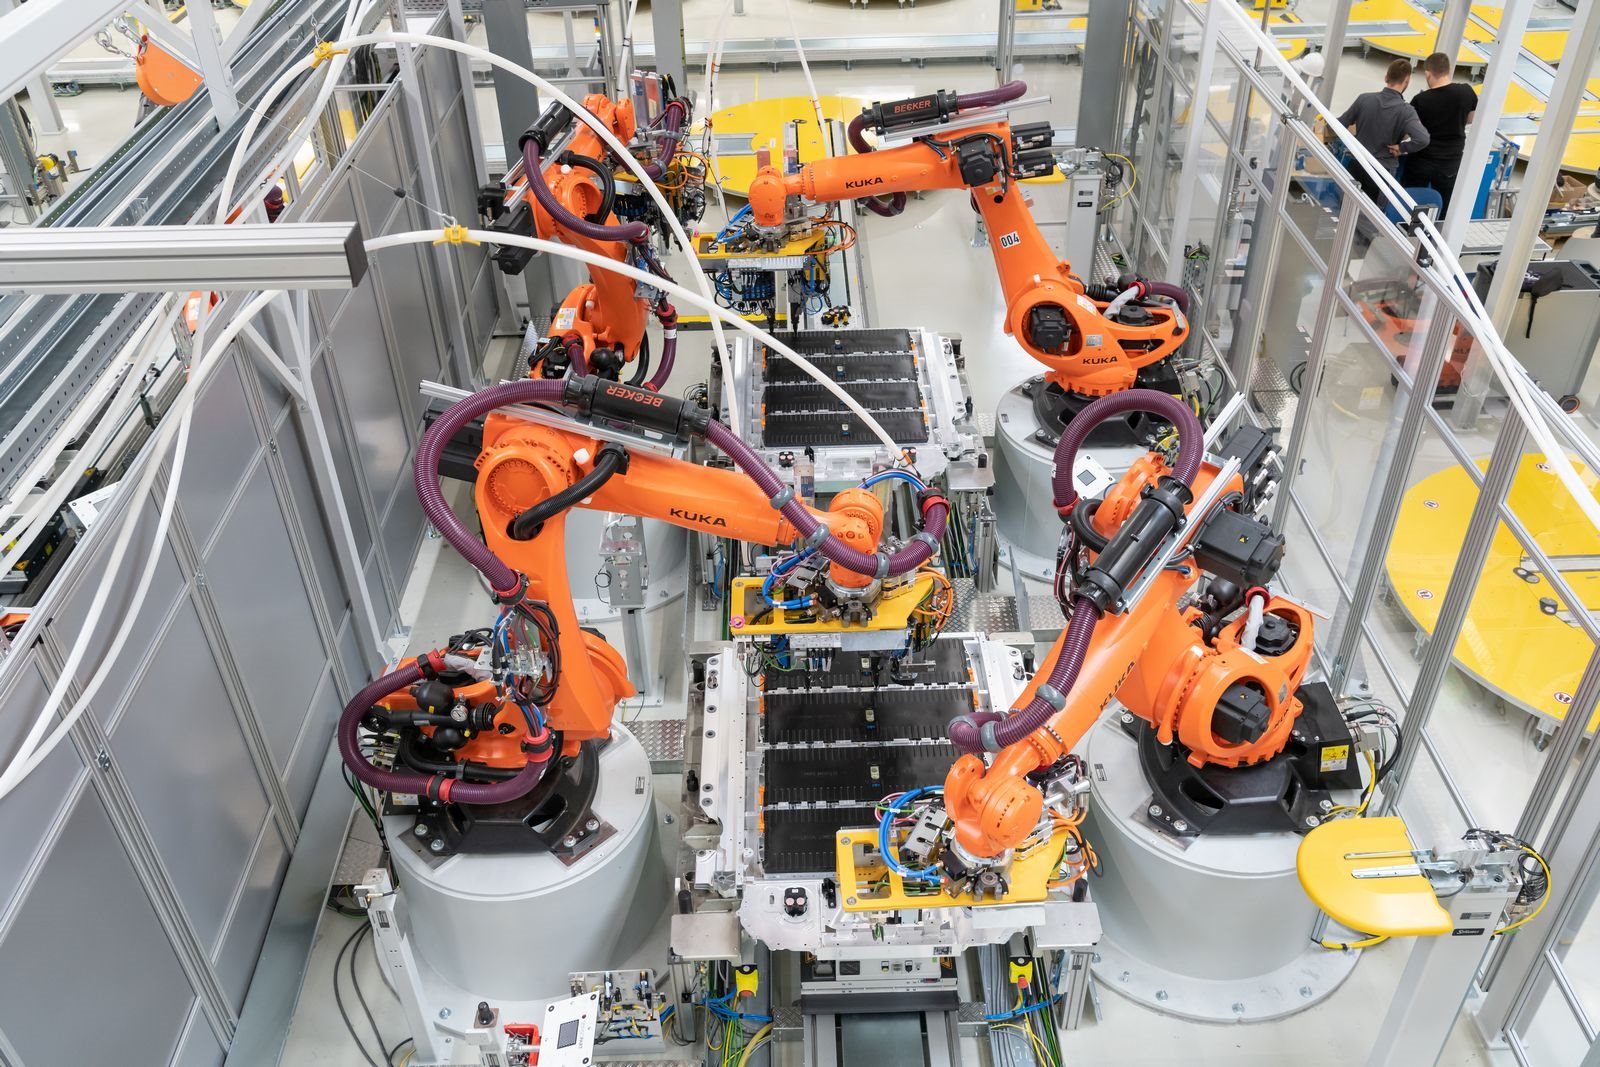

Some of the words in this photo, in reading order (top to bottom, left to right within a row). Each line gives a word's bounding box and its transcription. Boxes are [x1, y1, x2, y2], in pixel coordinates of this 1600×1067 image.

[894, 100, 932, 114] BECKER
[845, 177, 883, 189] KUKA
[1001, 233, 1019, 247] 004
[1082, 356, 1118, 365] KUKA
[607, 385, 664, 408] BECKER
[670, 508, 727, 527] KUKA
